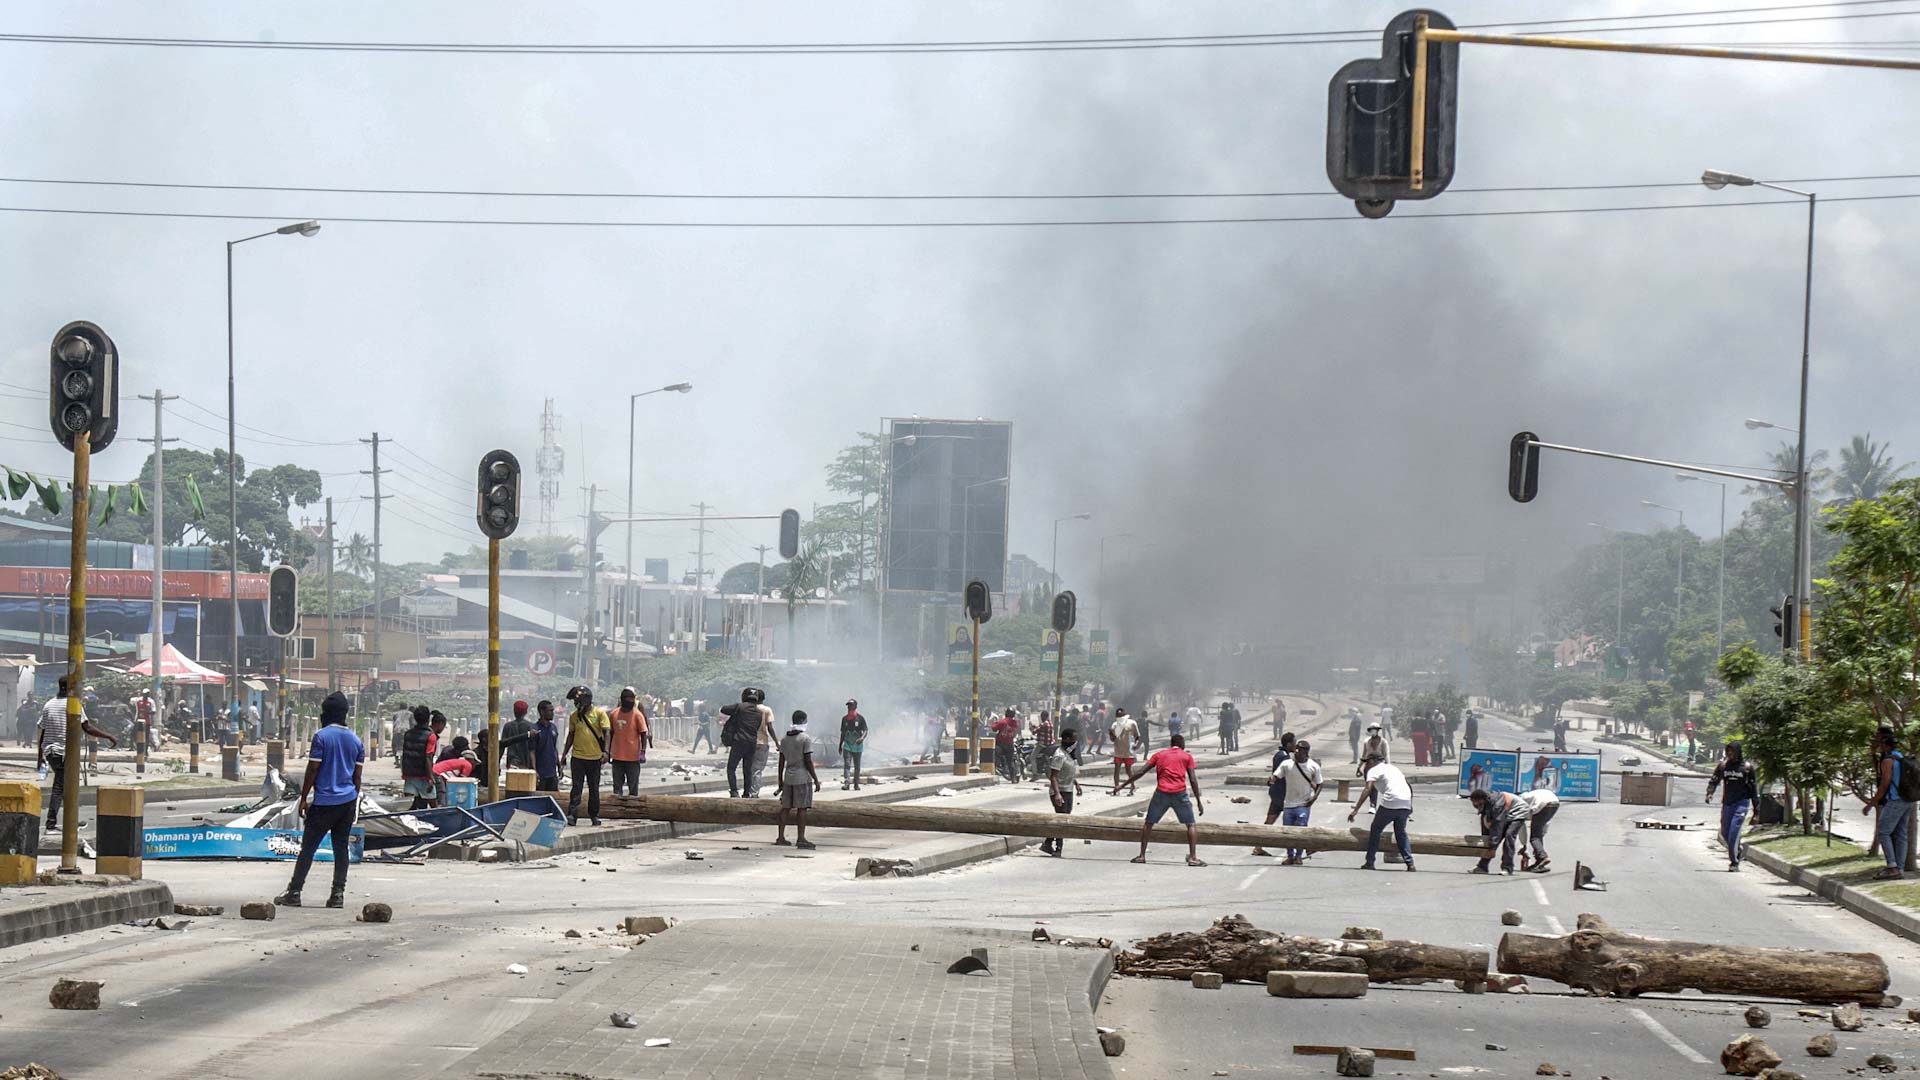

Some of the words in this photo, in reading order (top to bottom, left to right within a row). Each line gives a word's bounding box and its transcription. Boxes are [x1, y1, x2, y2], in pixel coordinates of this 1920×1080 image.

[534, 652, 550, 671] P
[145, 832, 190, 842] Dhamana
[192, 832, 203, 843] ya
[205, 831, 243, 841] Dereva
[146, 843, 177, 854] Makini
